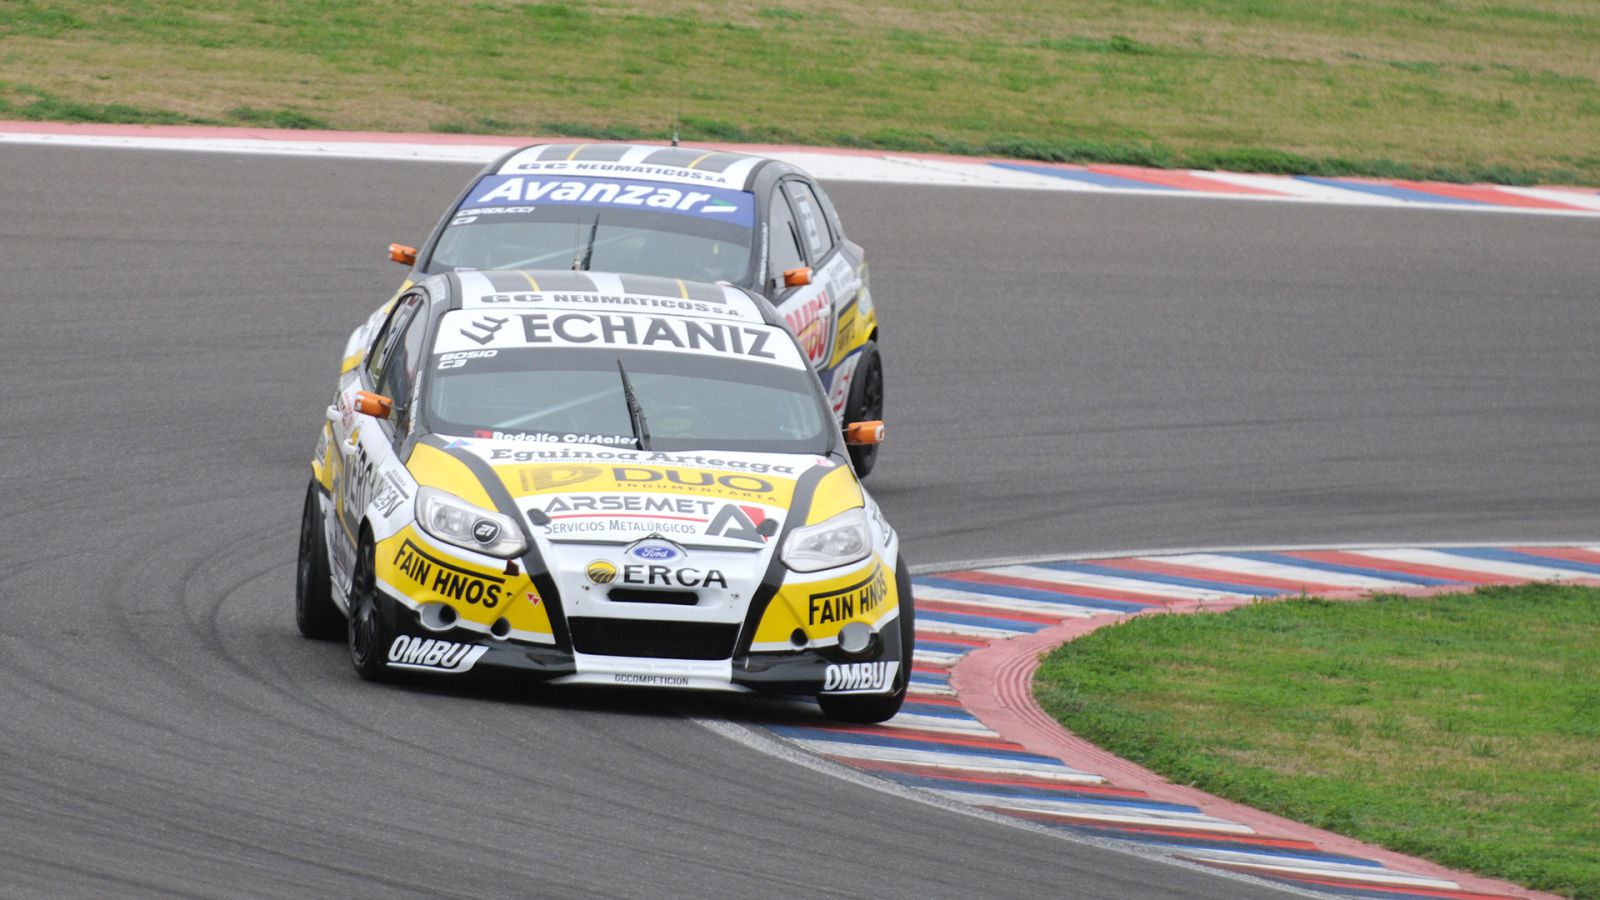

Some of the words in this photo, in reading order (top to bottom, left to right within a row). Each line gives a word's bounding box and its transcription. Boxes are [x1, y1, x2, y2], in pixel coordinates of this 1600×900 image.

[575, 163, 703, 179] NEUMATICOS
[477, 177, 711, 212] Avanzar
[481, 294, 543, 304] GC
[553, 294, 711, 312] NEUMATICOS
[517, 313, 776, 360] ECHANIZ
[437, 359, 468, 370] C3
[440, 349, 498, 361] BOSIO
[492, 431, 560, 443] Rodolfo
[563, 433, 638, 445] Cristales
[490, 449, 639, 462] Eguinoa
[646, 451, 795, 474] Arteaga
[612, 467, 774, 493] DUO
[544, 495, 715, 515] ARSEMET
[475, 524, 497, 537] 21
[393, 539, 432, 585] FAIN
[432, 568, 502, 608] HNOS
[623, 564, 728, 590] ERCA
[809, 593, 854, 626] FAIN
[860, 571, 888, 615] HNOS
[388, 634, 469, 668] OMBU
[824, 661, 886, 691] OMBU
